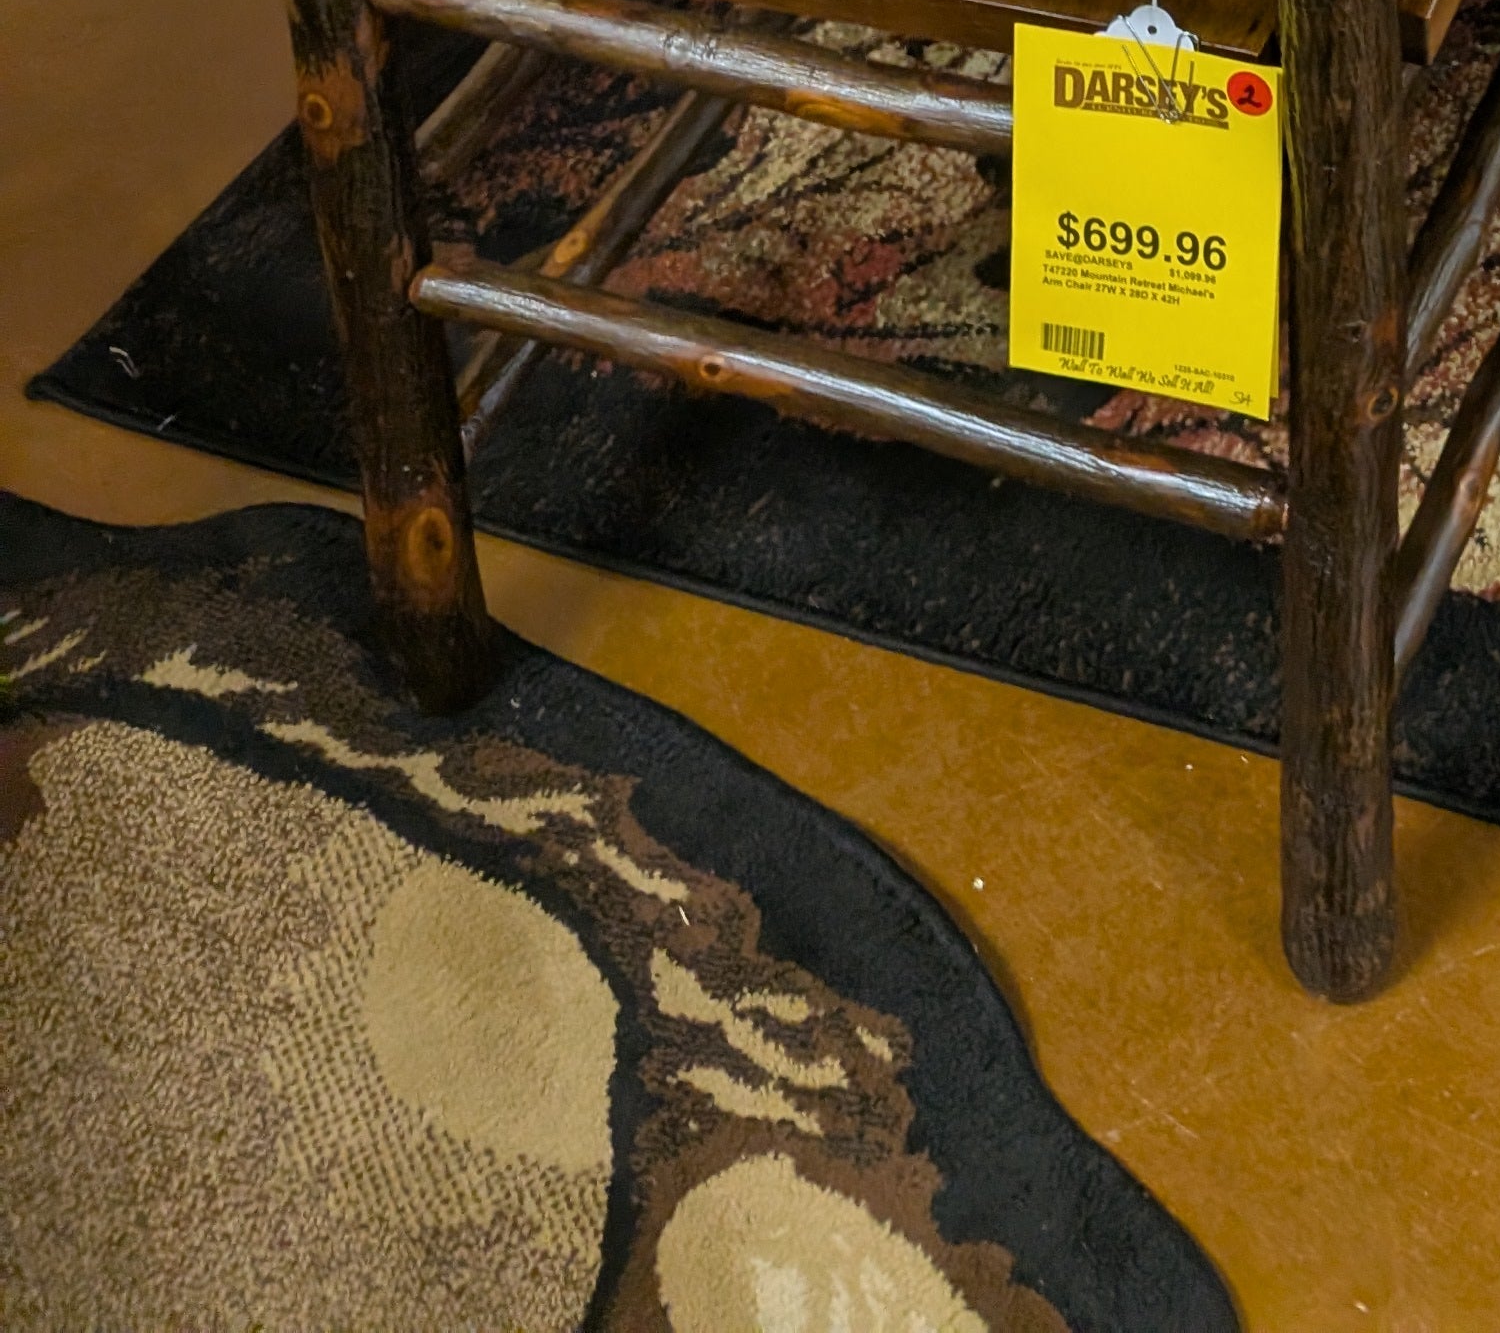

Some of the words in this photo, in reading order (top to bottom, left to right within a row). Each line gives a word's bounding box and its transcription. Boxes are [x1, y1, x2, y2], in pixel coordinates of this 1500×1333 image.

[1054, 65, 1229, 121] DARSEY'S
[1237, 84, 1262, 108] 2
[1057, 211, 1227, 271] $699.96
[1045, 250, 1133, 270] SAVE@DARSEYS
[1042, 276, 1063, 287] Arm
[1065, 279, 1092, 290] Chair
[1095, 282, 1117, 295] 27W
[1160, 293, 1180, 306] 42H
[1080, 269, 1127, 284] Mountain
[1129, 276, 1166, 291] Retreat
[1168, 282, 1215, 300] Michael's
[1059, 356, 1088, 372] Wall
[1088, 361, 1103, 376] To
[1106, 365, 1136, 381] Wall
[1136, 370, 1156, 385] We
[1158, 373, 1180, 389] Sell
[1180, 377, 1192, 392] It
